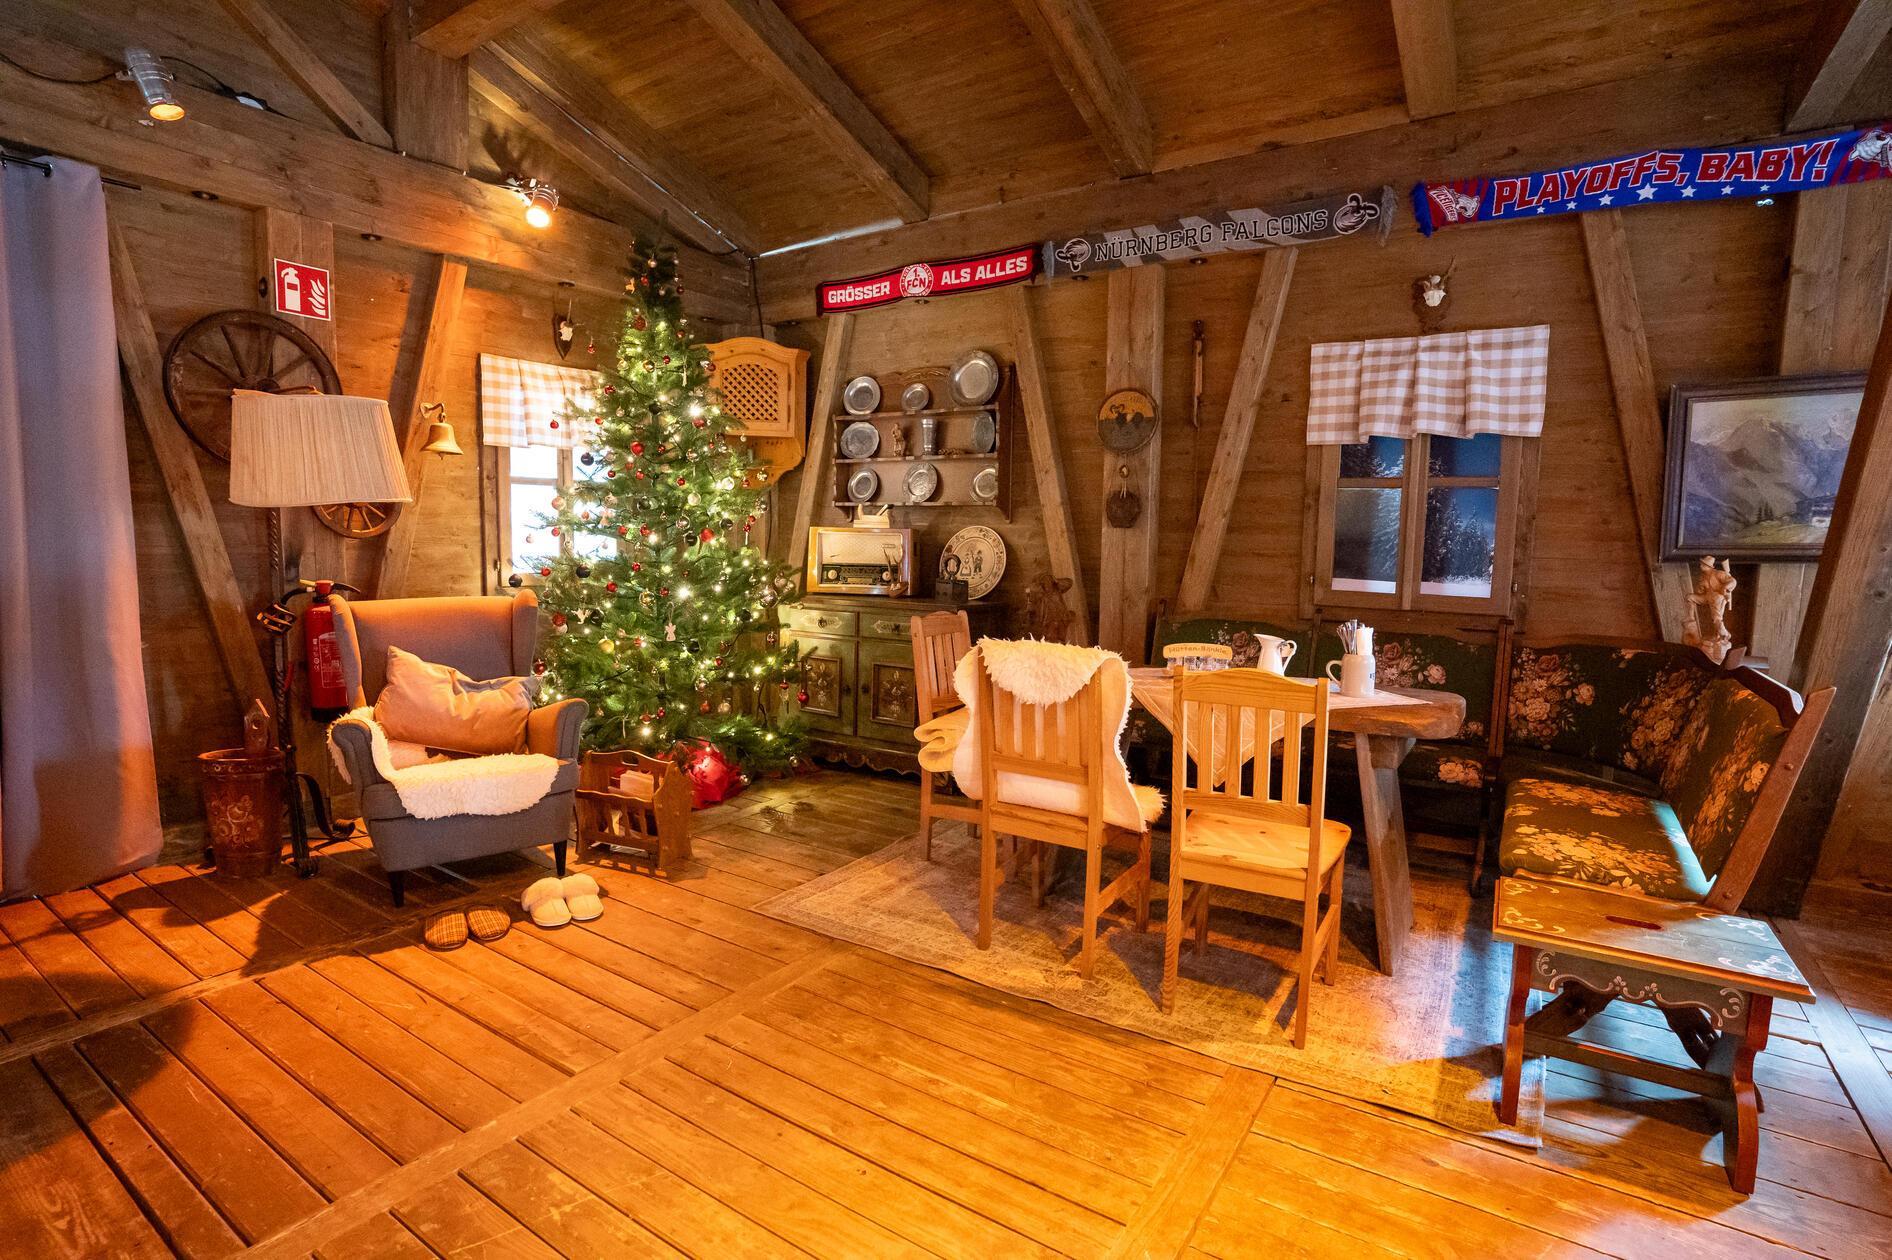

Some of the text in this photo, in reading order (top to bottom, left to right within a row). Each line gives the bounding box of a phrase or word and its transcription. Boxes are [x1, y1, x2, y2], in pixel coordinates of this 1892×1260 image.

[1492, 138, 1840, 216] PLAYOFFS, BABY!
[1095, 209, 1328, 262] NÜRNBERG FALCONS
[828, 281, 890, 304] GRÖSSER
[941, 270, 970, 286] ALS
[975, 256, 1028, 281] ALLES
[907, 277, 926, 290] FCN
[913, 268, 920, 277] 1.
